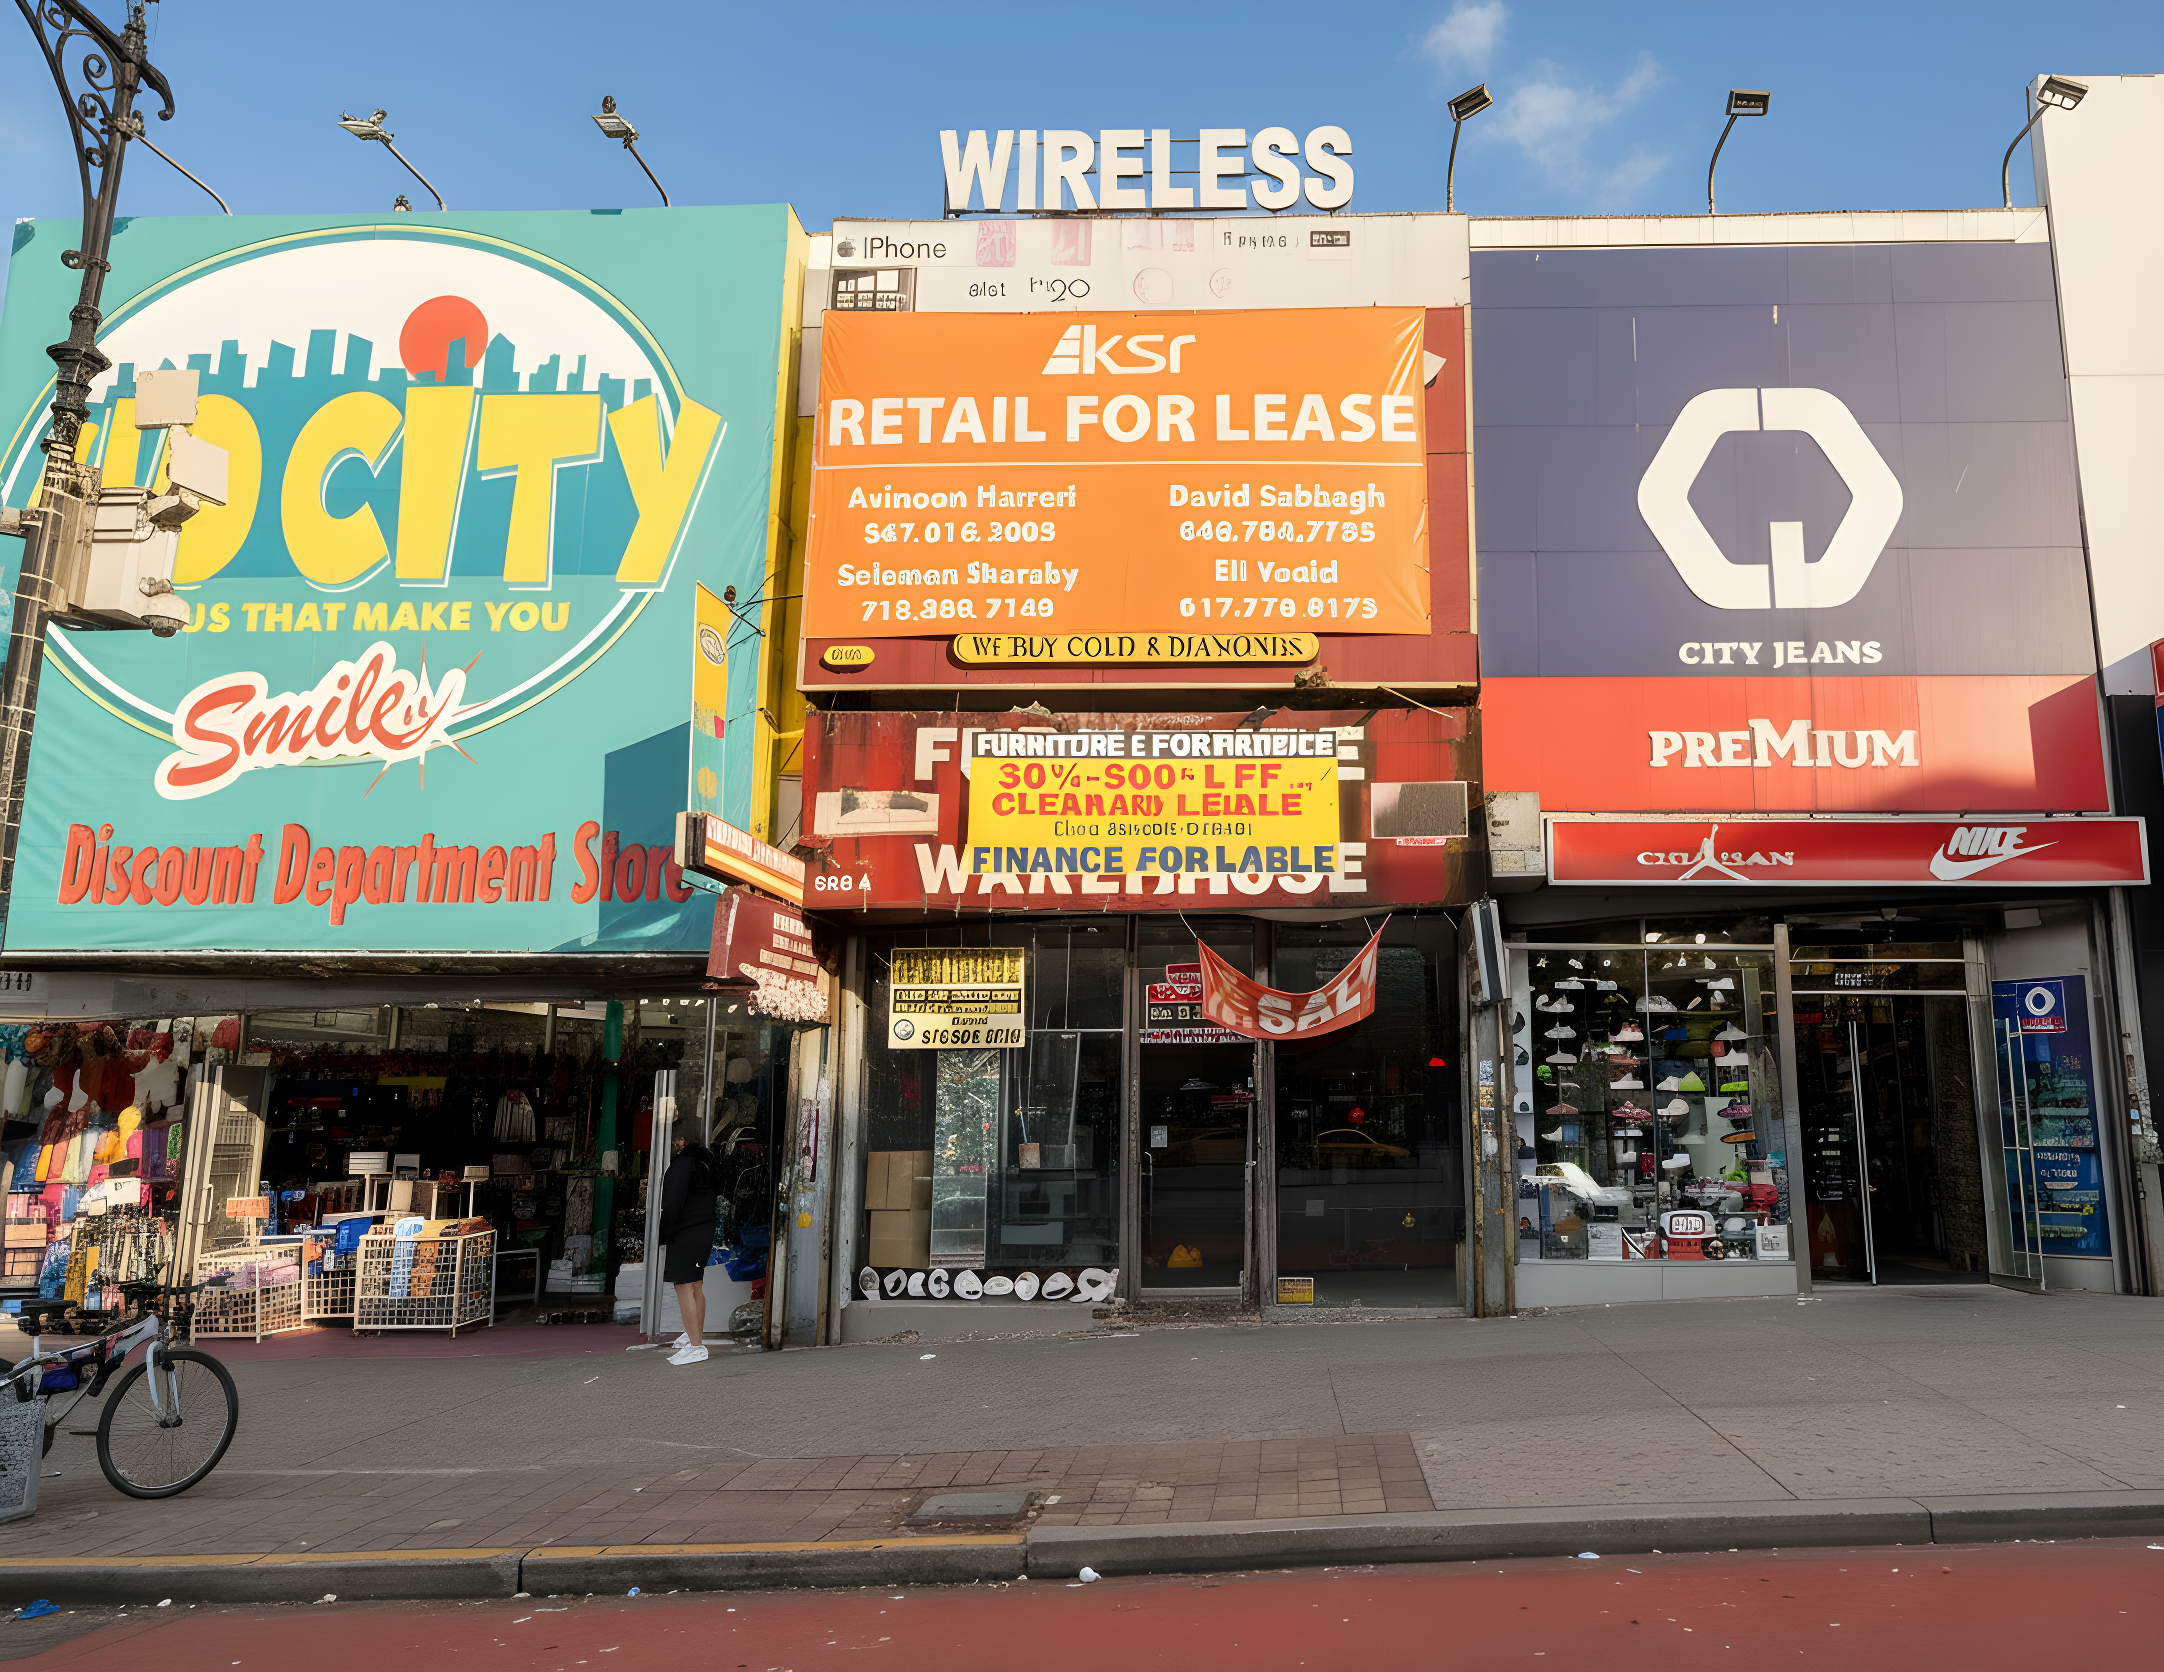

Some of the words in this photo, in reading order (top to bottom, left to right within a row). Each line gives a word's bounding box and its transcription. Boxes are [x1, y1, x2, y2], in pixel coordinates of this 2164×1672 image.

[940, 126, 1355, 212] WIRELESS
[829, 396, 1047, 446] RETAIL
[1066, 394, 1196, 443] FOR
[1216, 393, 1417, 442] LEASE
[281, 384, 722, 585] CITY
[1169, 483, 1250, 507] David
[241, 602, 346, 632] THAT
[353, 602, 472, 632] MAKE
[485, 601, 571, 633] YOU
[1007, 636, 1058, 658] BUY
[1678, 641, 1763, 665] CITY
[1773, 641, 1883, 669] JEANS
[1648, 718, 1920, 769] PREMIUM
[59, 823, 263, 906] Discount
[274, 823, 556, 927] Department
[973, 846, 1124, 874] FINANCE
